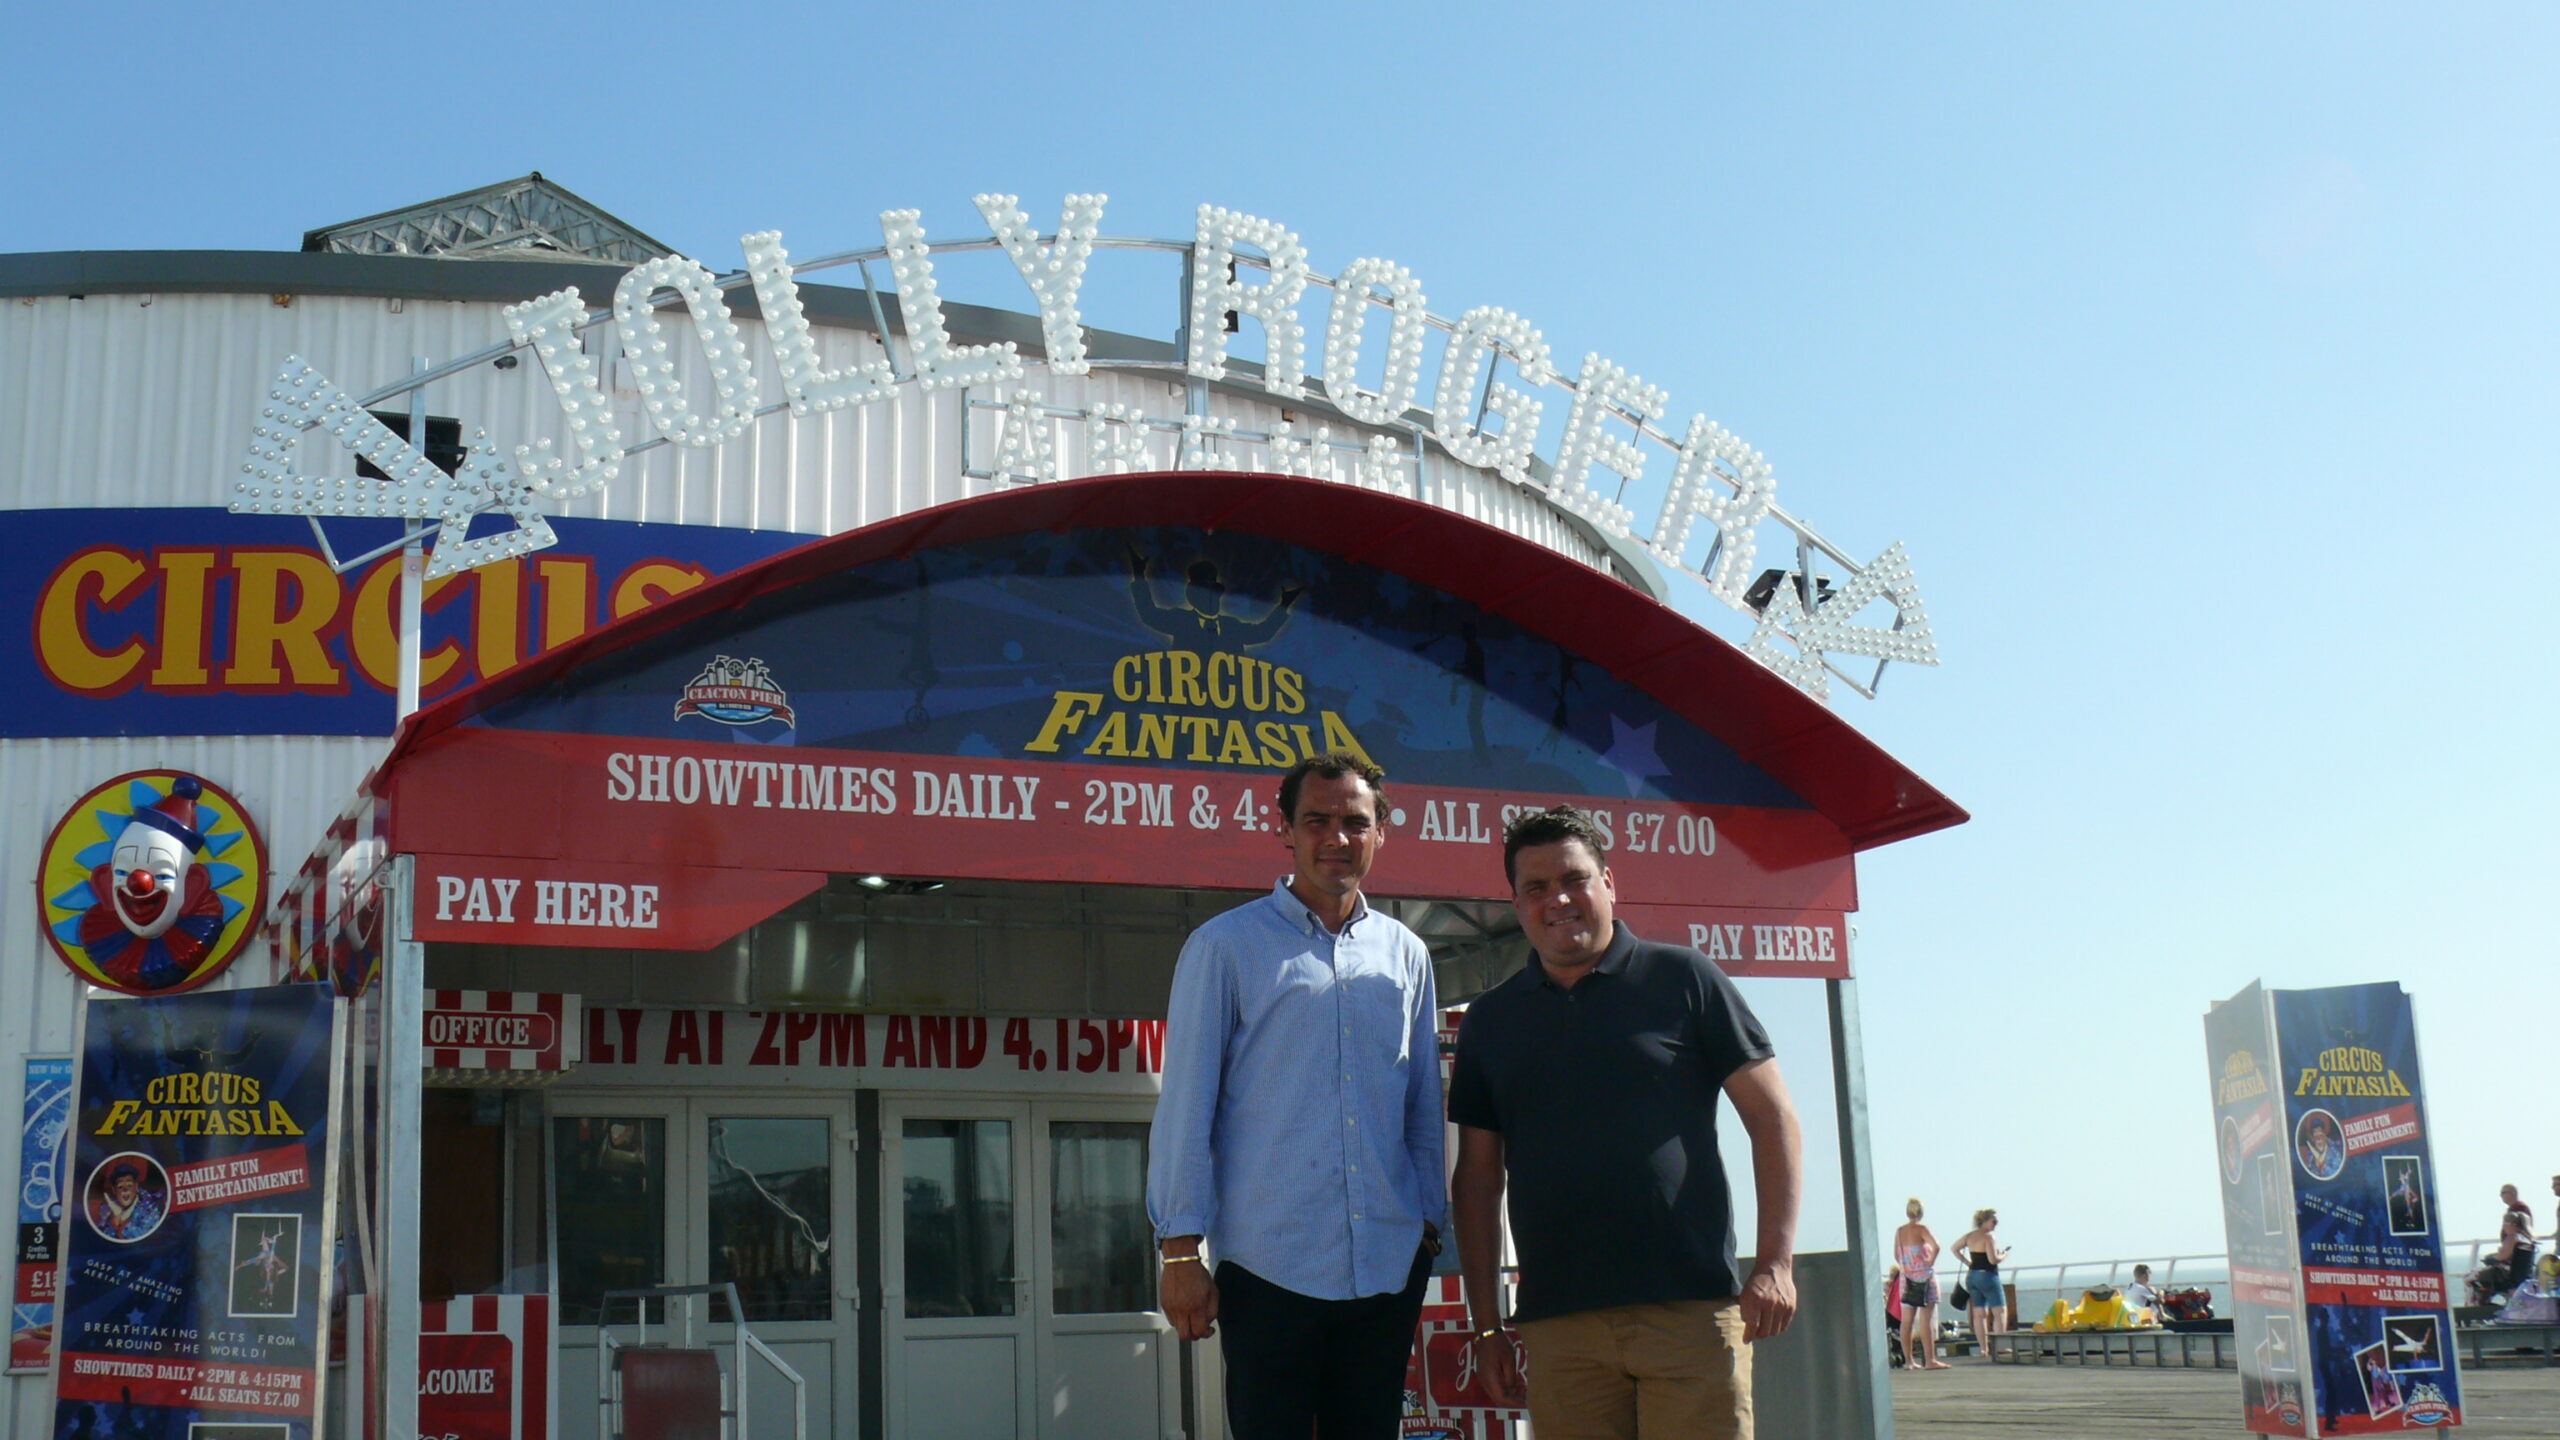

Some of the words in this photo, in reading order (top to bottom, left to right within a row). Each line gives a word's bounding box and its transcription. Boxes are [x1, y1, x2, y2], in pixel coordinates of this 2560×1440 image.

[502, 192, 1109, 500] JOLLY
[1186, 202, 1777, 610] ROGER
[688, 687, 748, 700] CLACTON
[750, 689, 782, 705] PIER
[1112, 650, 1307, 715] CIRCUS
[1023, 690, 1383, 769] FANTASIA
[607, 752, 897, 815] SHOWTIMES
[912, 770, 1040, 820] DAILY
[1084, 779, 1175, 829] 2PM
[1189, 785, 1221, 831] &
[1420, 799, 1492, 844] ALL
[1625, 813, 1717, 857] £7.00
[435, 875, 522, 923] PAY
[533, 879, 659, 929] HERE
[1688, 924, 1744, 960] PAY
[1752, 925, 1836, 962] HERE
[429, 1014, 530, 1046] OFFICE
[749, 1011, 867, 1068] 2PM
[883, 1014, 987, 1069] AND
[1003, 1016, 1168, 1074] 4.15PM
[2319, 1046, 2384, 1073] CIRCUS
[146, 1071, 261, 1105] CIRCUS
[2294, 1068, 2412, 1097] FANTASIA
[94, 1100, 305, 1136] FANTASIA
[2344, 1117, 2374, 1137] FAMILY
[2374, 1114, 2392, 1129] FUN
[2347, 1122, 2417, 1150] ENTERTAINMENT!
[174, 1163, 228, 1188] FAMILY
[230, 1158, 260, 1180] FUN
[176, 1168, 305, 1206] ENTERTAINMENT!
[33, 1226, 44, 1244] 3
[2311, 1242, 2377, 1254] BREATHTAKING
[2382, 1246, 2404, 1256] ACTS
[2409, 1247, 2432, 1257] FROM
[2325, 1254, 2360, 1264] AROUND
[2364, 1255, 2380, 1265] THE
[83, 1268, 121, 1286] AERIAL
[86, 1259, 112, 1271] GASP
[118, 1269, 132, 1279] AT
[137, 1276, 183, 1296] AMAZING
[2309, 1272, 2357, 1285] SHOWTIMES
[2357, 1274, 2380, 1286] DAILY
[2385, 1275, 2403, 1287] 2PM
[2411, 1277, 2439, 1289] 4:15PM
[2378, 1289, 2394, 1301] ALL
[2394, 1290, 2418, 1302] SEATS
[2419, 1291, 2440, 1303] £7.00
[84, 1321, 199, 1340] BREATHTAKING
[208, 1331, 246, 1343] ACTS
[257, 1334, 296, 1347] FROM
[105, 1338, 163, 1351] AROUND
[174, 1342, 200, 1355] THE
[210, 1344, 267, 1359] WORLD!
[73, 1358, 154, 1379] SHOWTIMES
[156, 1364, 196, 1382] DAILY
[206, 1368, 235, 1385] 2PM
[239, 1370, 250, 1386] &
[252, 1371, 303, 1389] 4:15PM
[189, 1386, 215, 1402] ALL
[218, 1387, 261, 1405] SEATS
[263, 1391, 300, 1408] £7.00
[1429, 1417, 1455, 1430] PIER
